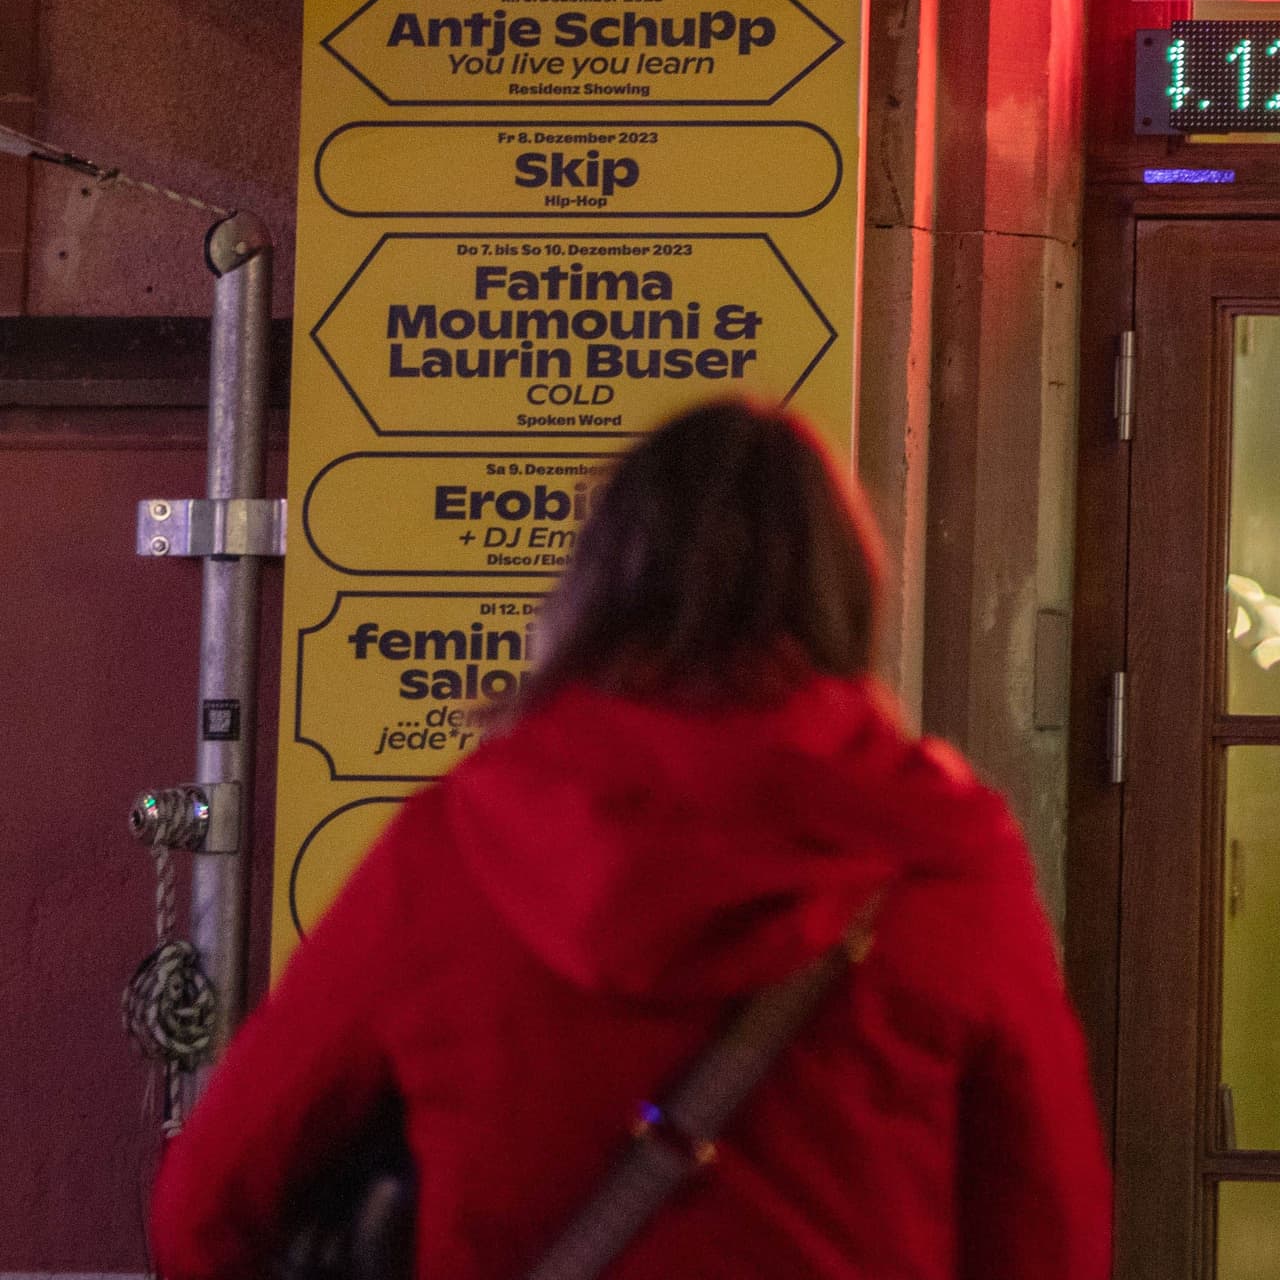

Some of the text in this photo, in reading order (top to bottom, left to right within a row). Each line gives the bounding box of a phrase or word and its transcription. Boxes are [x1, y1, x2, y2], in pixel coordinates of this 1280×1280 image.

[387, 10, 776, 56] Antje Schupp
[448, 53, 714, 80] You live you learn
[509, 83, 650, 97] Residenz Showing
[498, 133, 657, 144] Fr 8. Dezember 2023
[515, 151, 639, 196] Skip
[545, 195, 607, 208] Hip-Hop
[457, 244, 692, 256] Do 7. bis So 10. Dezember 2023
[475, 263, 672, 301] Fatima
[387, 302, 762, 339] Moumouni &
[390, 341, 757, 379] Laurin Buser
[527, 384, 614, 405] COLD
[517, 414, 621, 428] Spoken Word
[487, 464, 505, 475] Sa
[510, 464, 522, 475] 9.
[460, 532, 476, 544] +
[484, 527, 521, 547] DJ
[480, 604, 495, 615] Di
[500, 604, 520, 615] 12.
